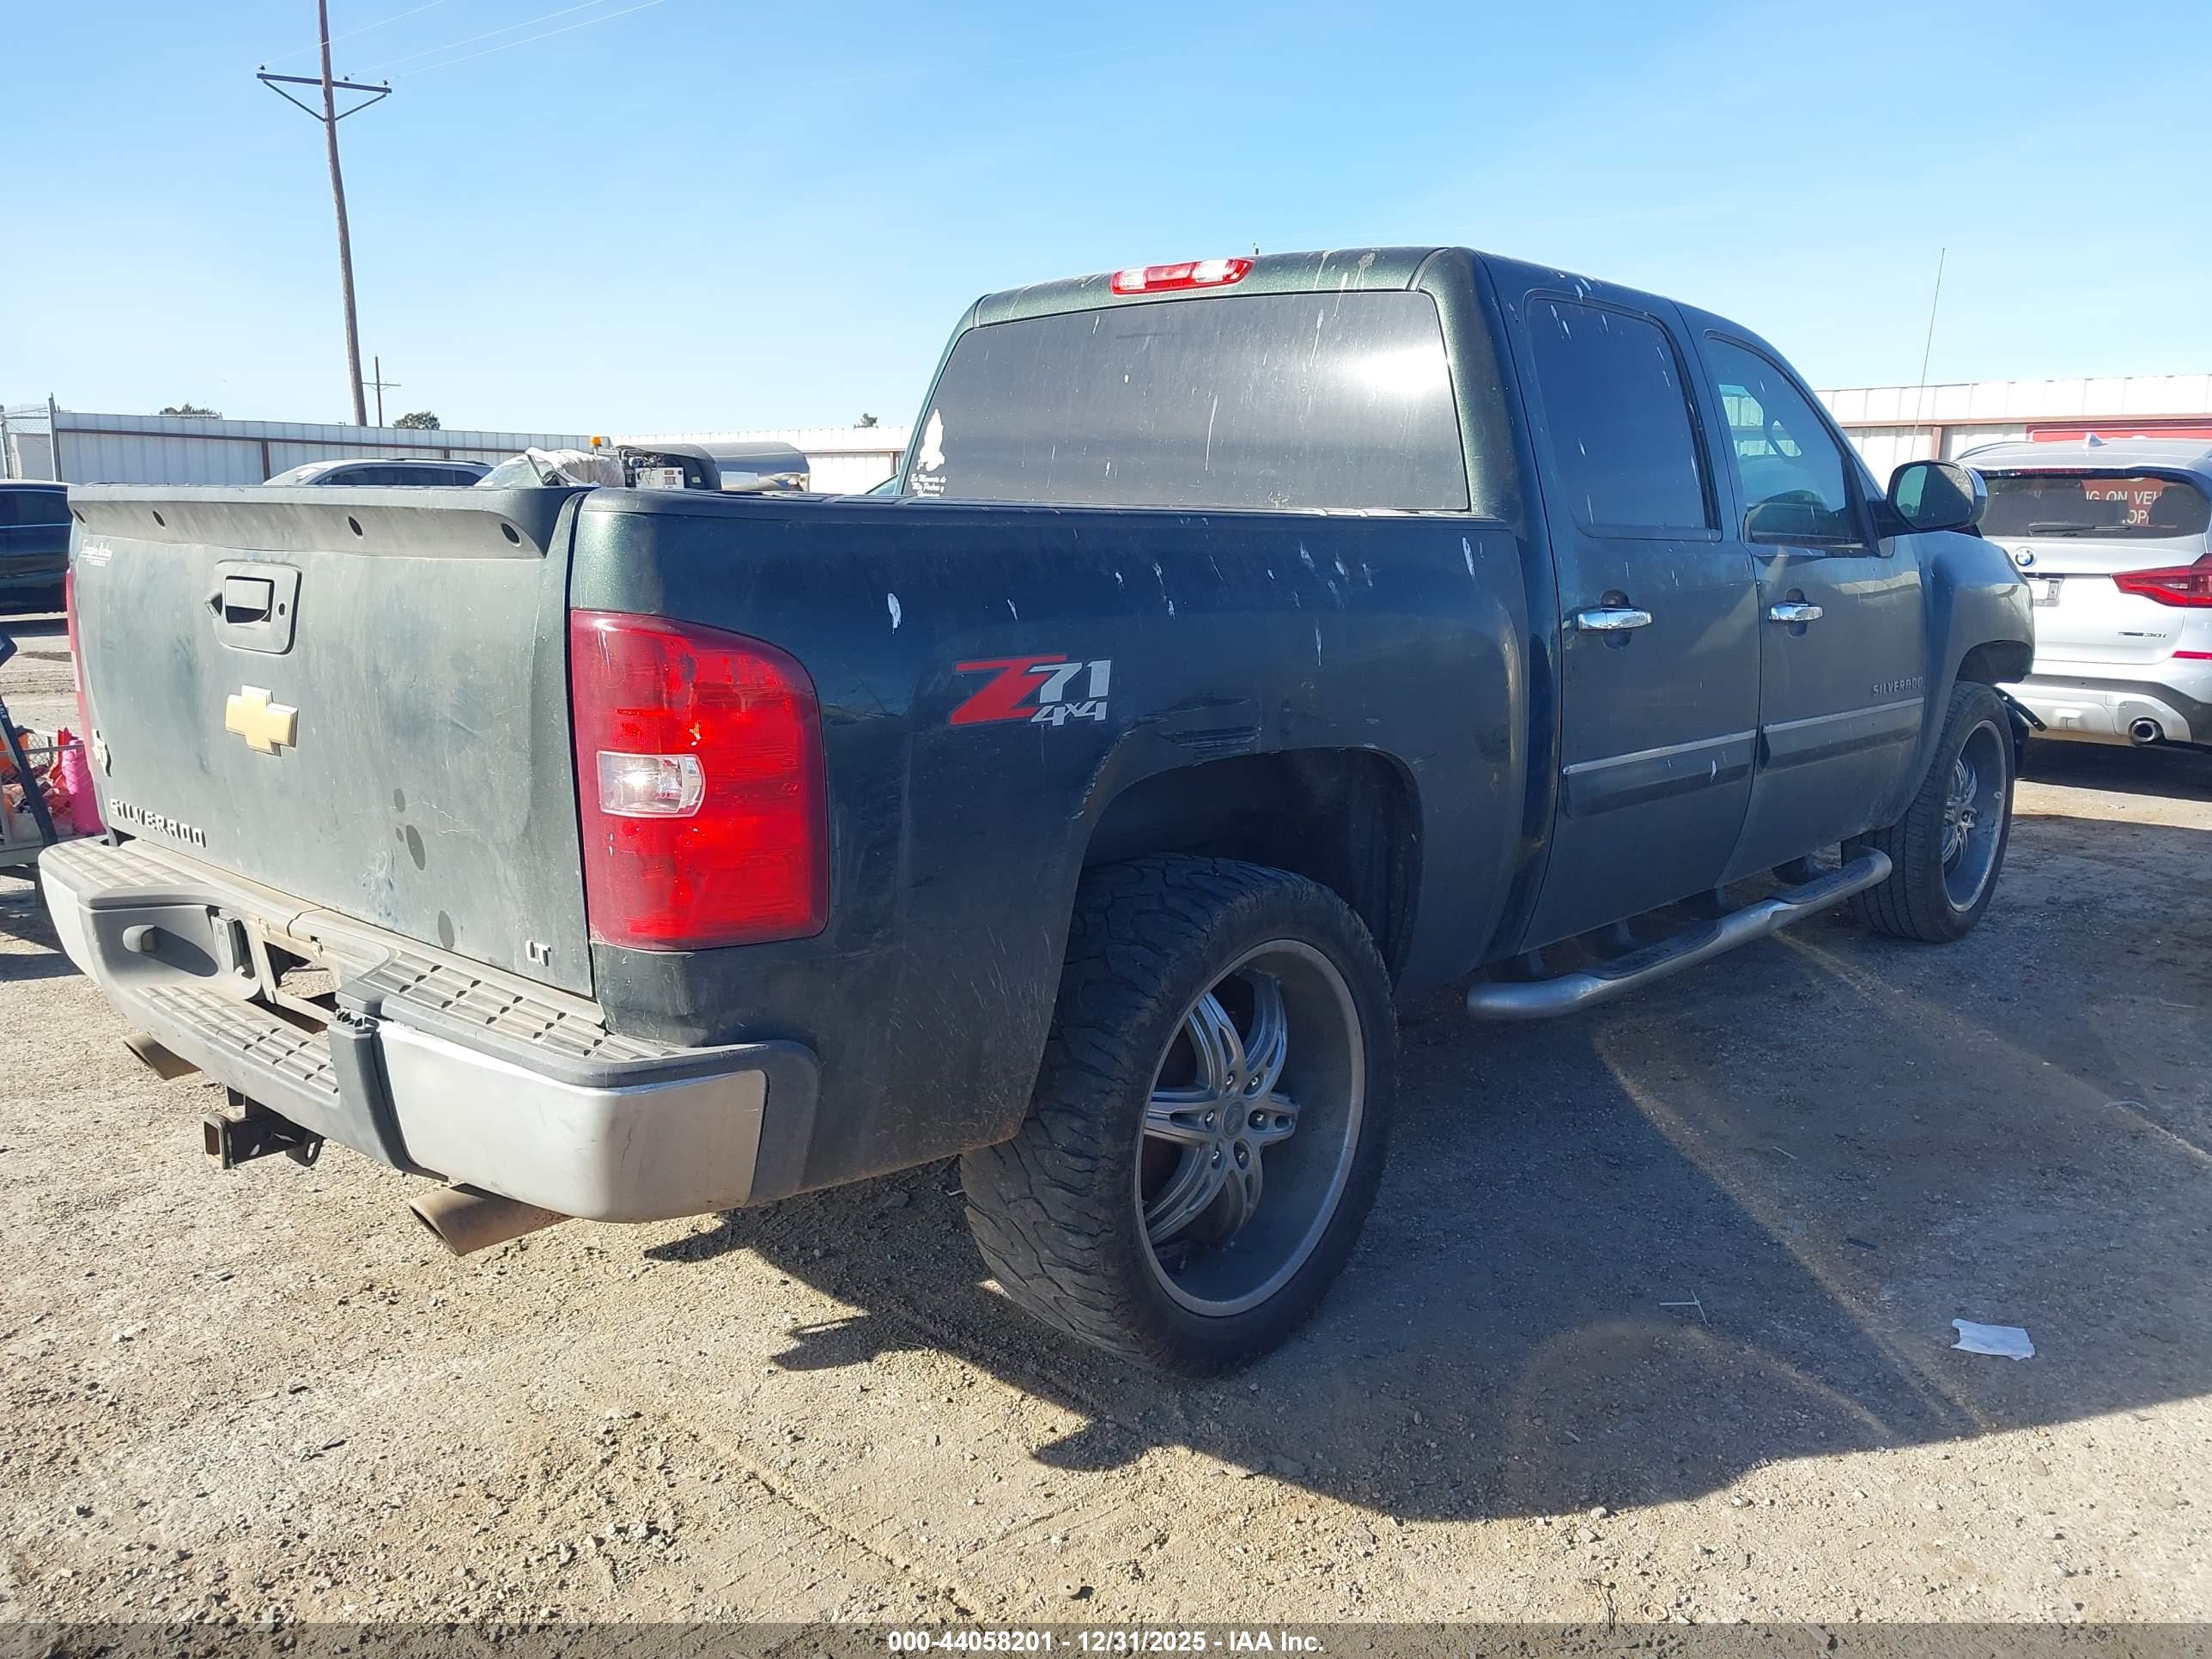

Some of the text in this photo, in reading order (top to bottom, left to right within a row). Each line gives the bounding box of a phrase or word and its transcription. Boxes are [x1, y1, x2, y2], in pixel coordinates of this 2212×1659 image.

[950, 654, 1112, 725] Z71
[1873, 676, 1923, 696] SILVERADO
[110, 798, 207, 848] SILVERADO
[526, 939, 552, 968] LT
